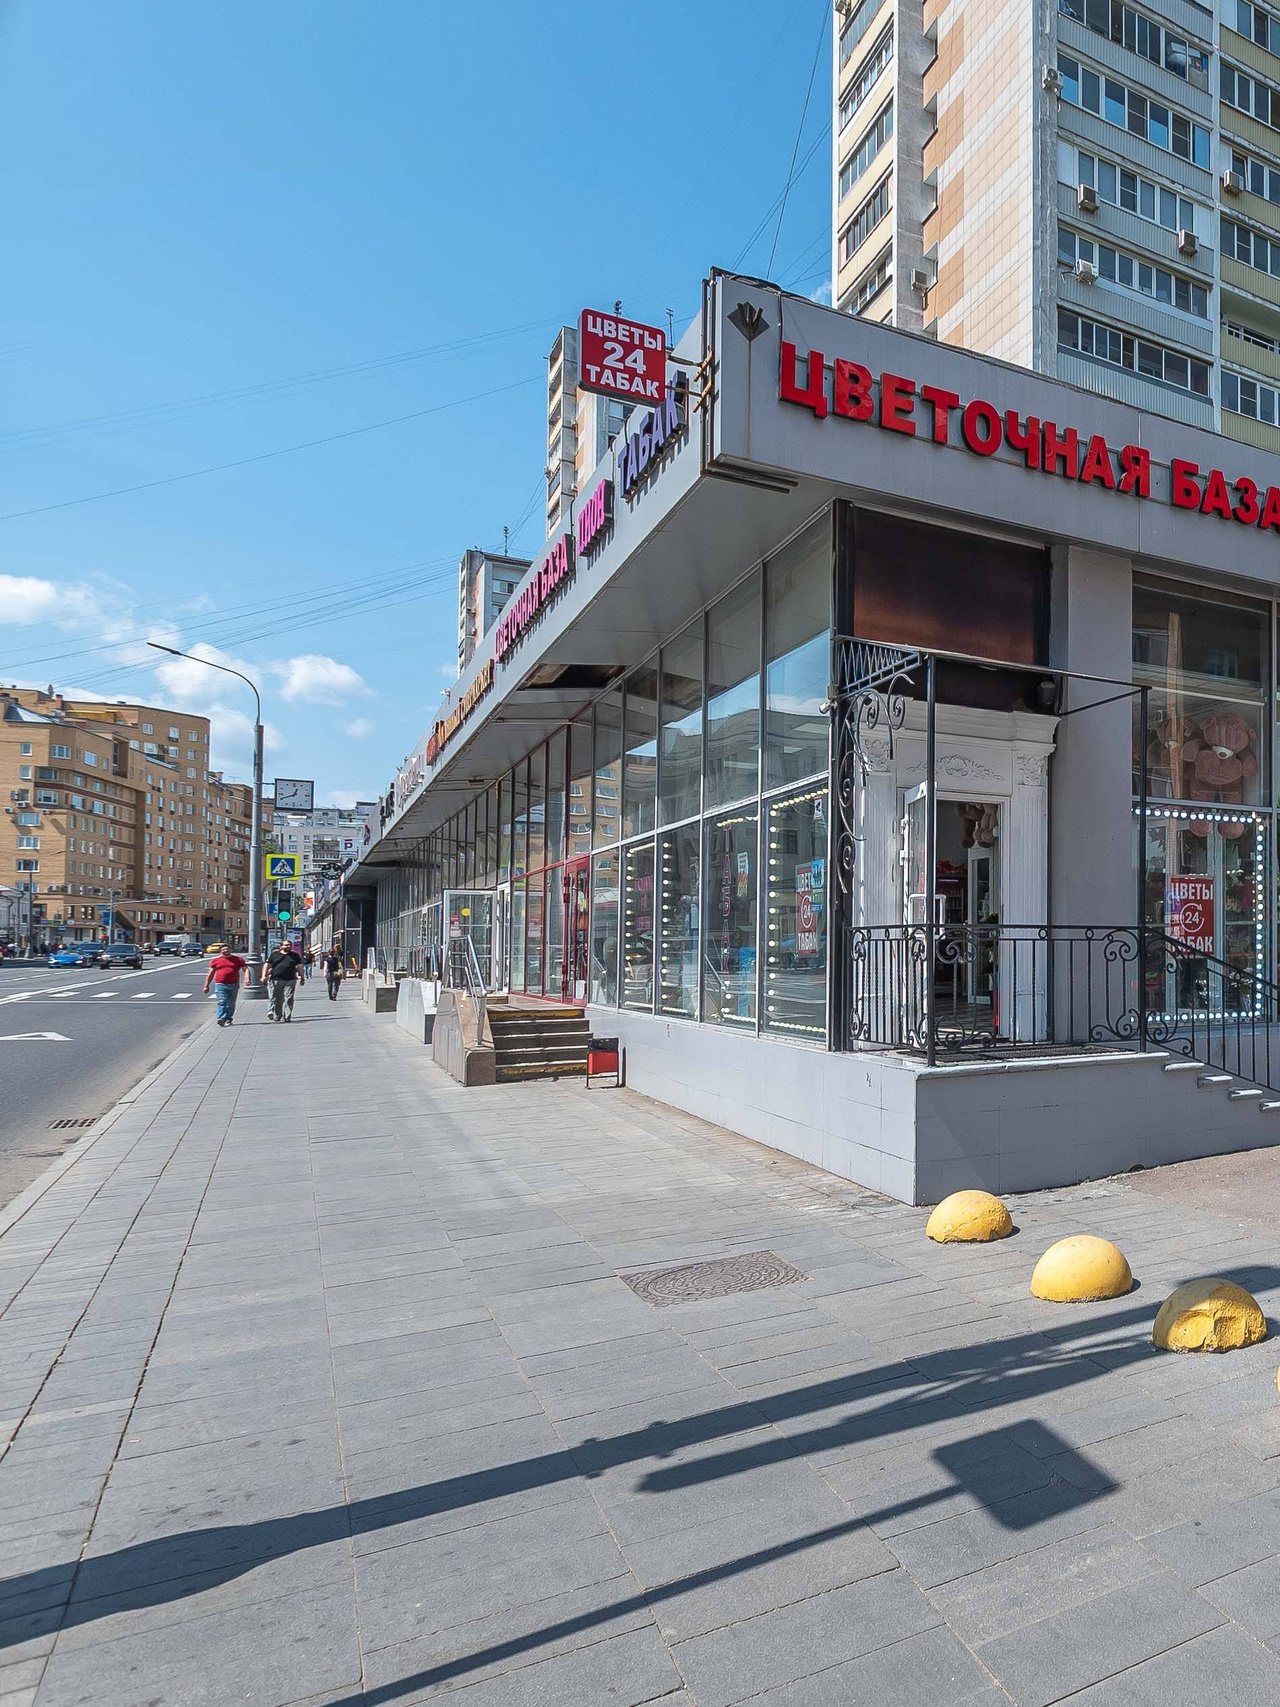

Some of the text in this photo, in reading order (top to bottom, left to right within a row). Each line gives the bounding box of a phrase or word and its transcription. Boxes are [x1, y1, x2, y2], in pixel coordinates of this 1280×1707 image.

[587, 314, 662, 351] ЦВЕТЫ
[602, 341, 647, 375] 24
[585, 363, 660, 399] ТАБАК
[618, 370, 684, 498] ТАБАК
[778, 340, 1151, 498] ЦВЕТОЧНАЯ
[494, 479, 608, 663] ЦВЕТОЧНАЯ БАЗА ПИОН
[1171, 882, 1213, 901] ЦВЕТЫ
[803, 904, 812, 919] 24
[1185, 911, 1200, 924] 24
